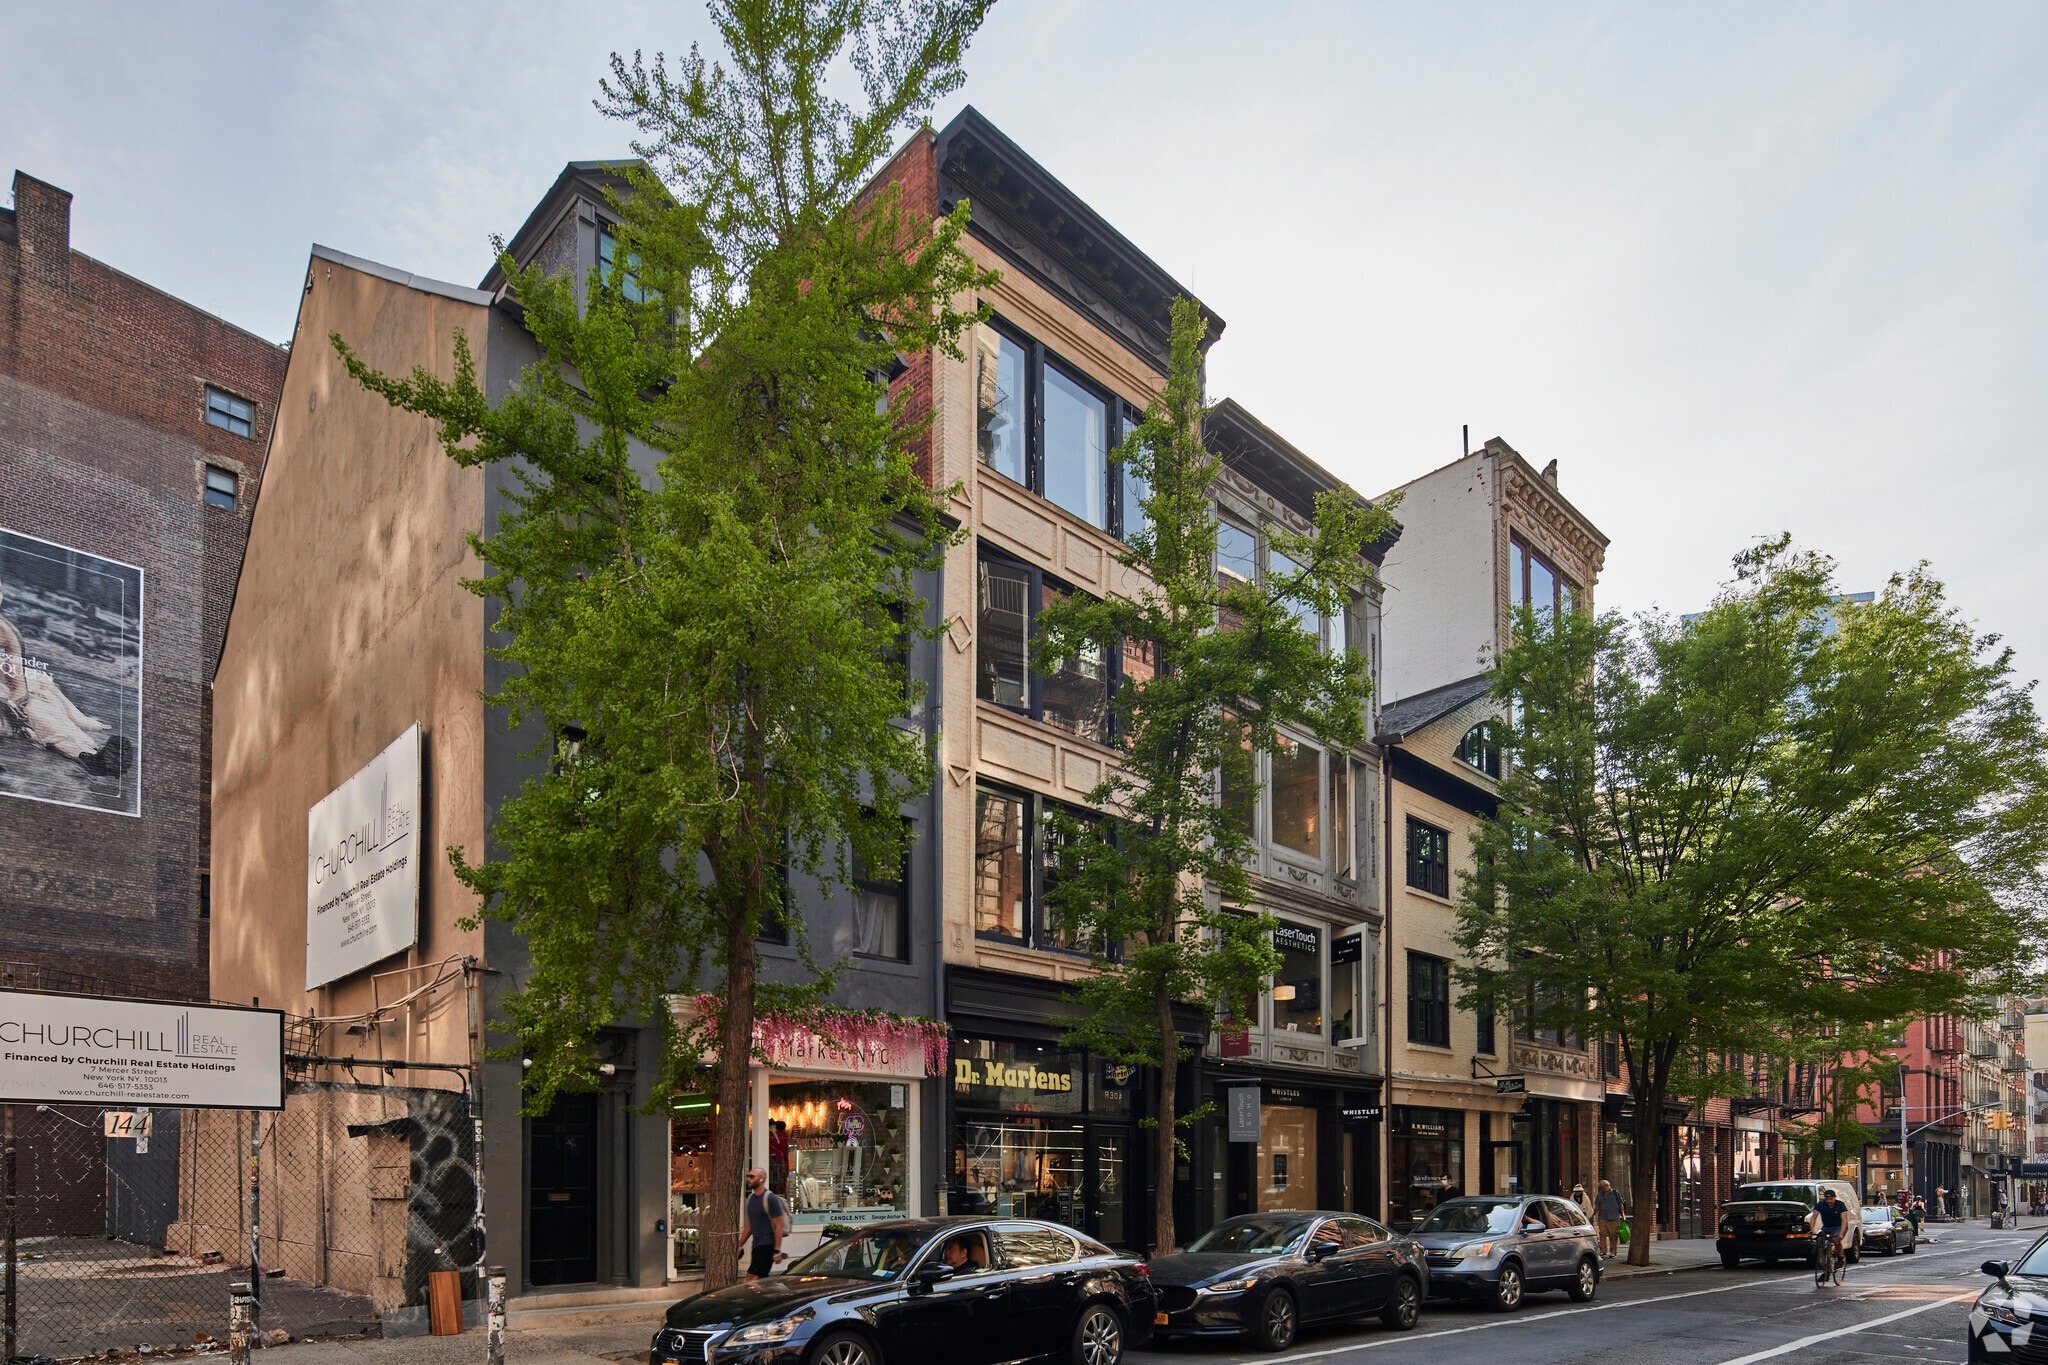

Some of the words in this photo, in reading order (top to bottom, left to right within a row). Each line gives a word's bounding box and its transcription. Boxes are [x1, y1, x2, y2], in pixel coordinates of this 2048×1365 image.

[387, 801, 404, 822] REAL
[387, 811, 410, 838] ESTATE
[315, 818, 379, 884] CHURCHILL
[316, 896, 335, 916] Financed
[334, 896, 340, 906] by
[340, 881, 360, 902] Churchill
[360, 876, 371, 890] Real
[370, 869, 385, 885] Estate
[385, 856, 408, 876] Holdings
[360, 890, 372, 903] Street
[342, 915, 350, 924] New
[1275, 927, 1316, 944] LaserTouch
[1275, 937, 1316, 952] AESTHETICS
[0, 1021, 173, 1053] CHURCHILL
[192, 1034, 225, 1046] REAL
[192, 1043, 238, 1055] ESTATE
[857, 1047, 889, 1065] NYC
[4, 1052, 58, 1063] Financed
[61, 1055, 75, 1065] by
[77, 1056, 127, 1066] Churchill
[156, 1060, 189, 1069] Estate
[191, 1062, 236, 1072] Holdings
[83, 1073, 103, 1081] New
[105, 1074, 125, 1082] York
[98, 1066, 129, 1074] Mercer
[955, 1058, 980, 1085] Dr.
[985, 1061, 1072, 1092] Martens
[97, 1082, 154, 1091] 646-517-5353
[1271, 1087, 1300, 1097] WHISTLES
[58, 1089, 190, 1100] www.churchill-realestate.com
[1342, 1108, 1379, 1116] WHISTLES
[109, 1114, 151, 1135] 144
